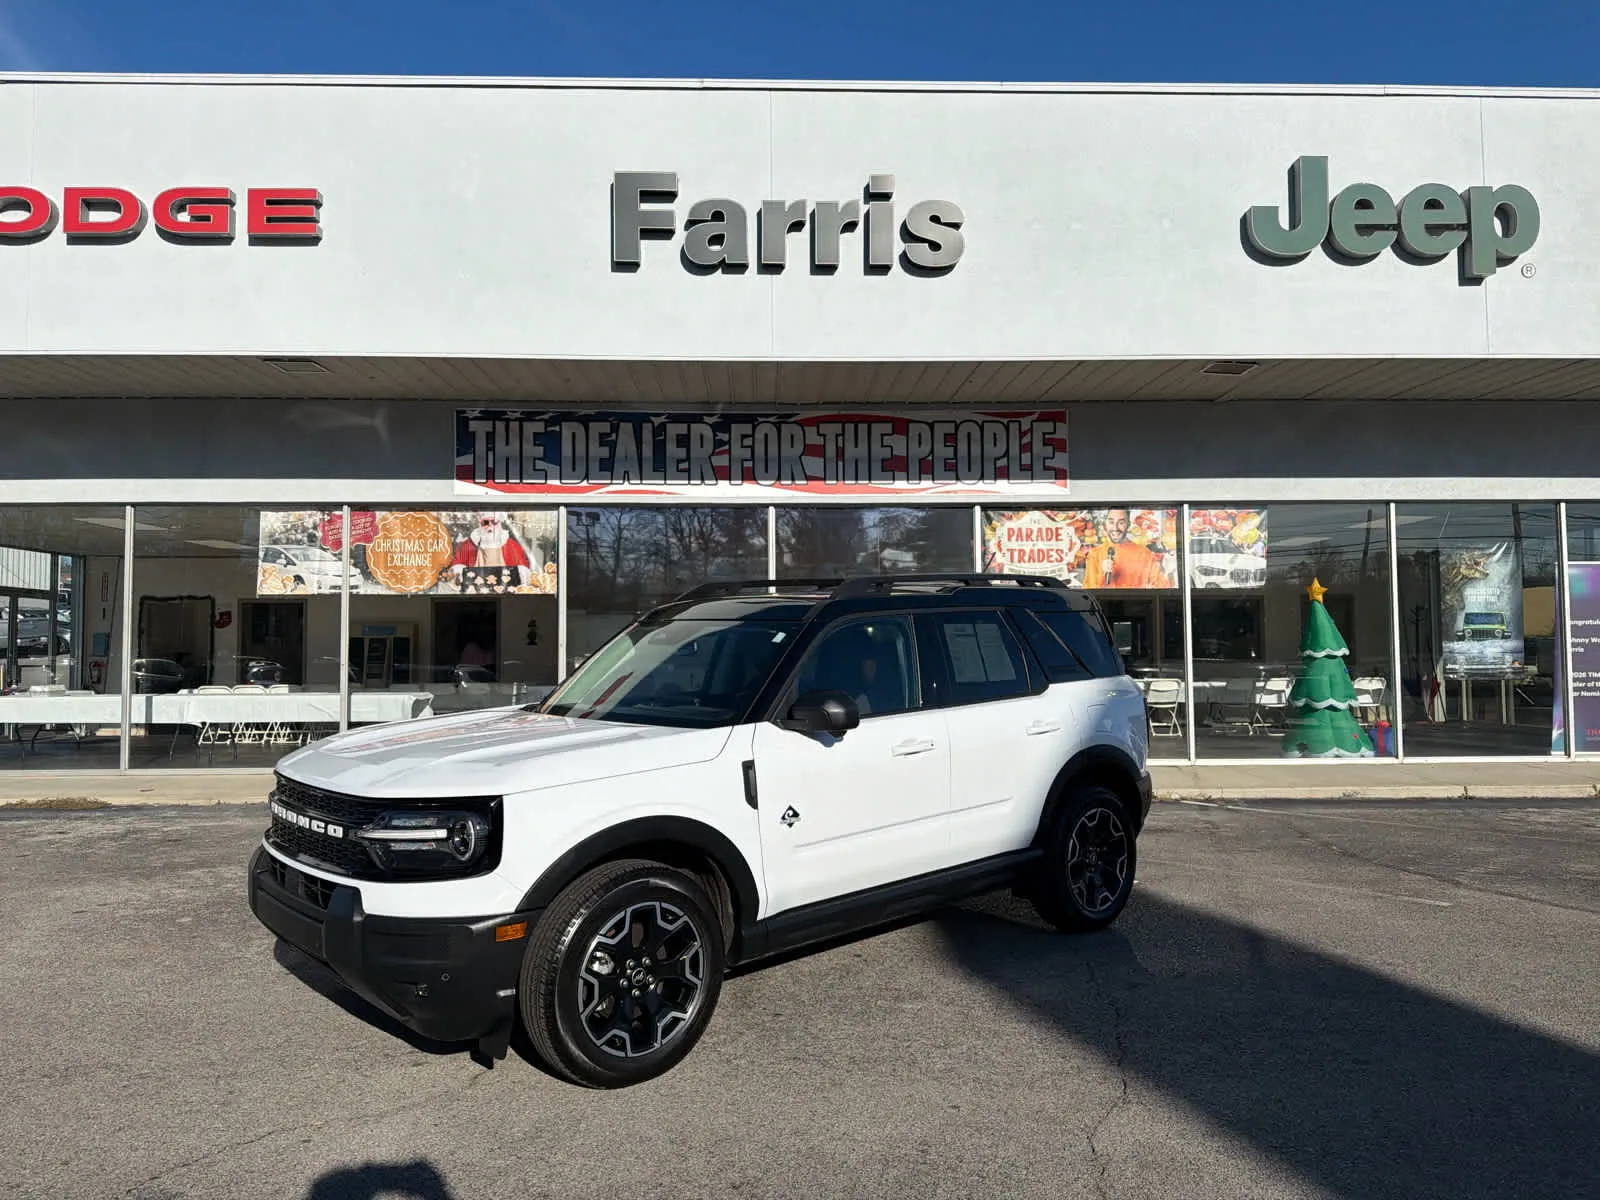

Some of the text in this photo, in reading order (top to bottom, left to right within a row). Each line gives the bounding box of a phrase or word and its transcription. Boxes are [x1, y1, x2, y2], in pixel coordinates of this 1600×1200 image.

[0, 186, 323, 247] ODGE
[609, 170, 966, 278] Farris
[1240, 155, 1541, 287] Jeep
[468, 418, 1057, 487] THE DEALER FOR THE PEOPLE
[375, 538, 445, 553] CHRISTMAS CAR
[1007, 527, 1063, 542] PARADE
[387, 552, 433, 567] EXCHANGE
[1007, 548, 1064, 564] TRADES
